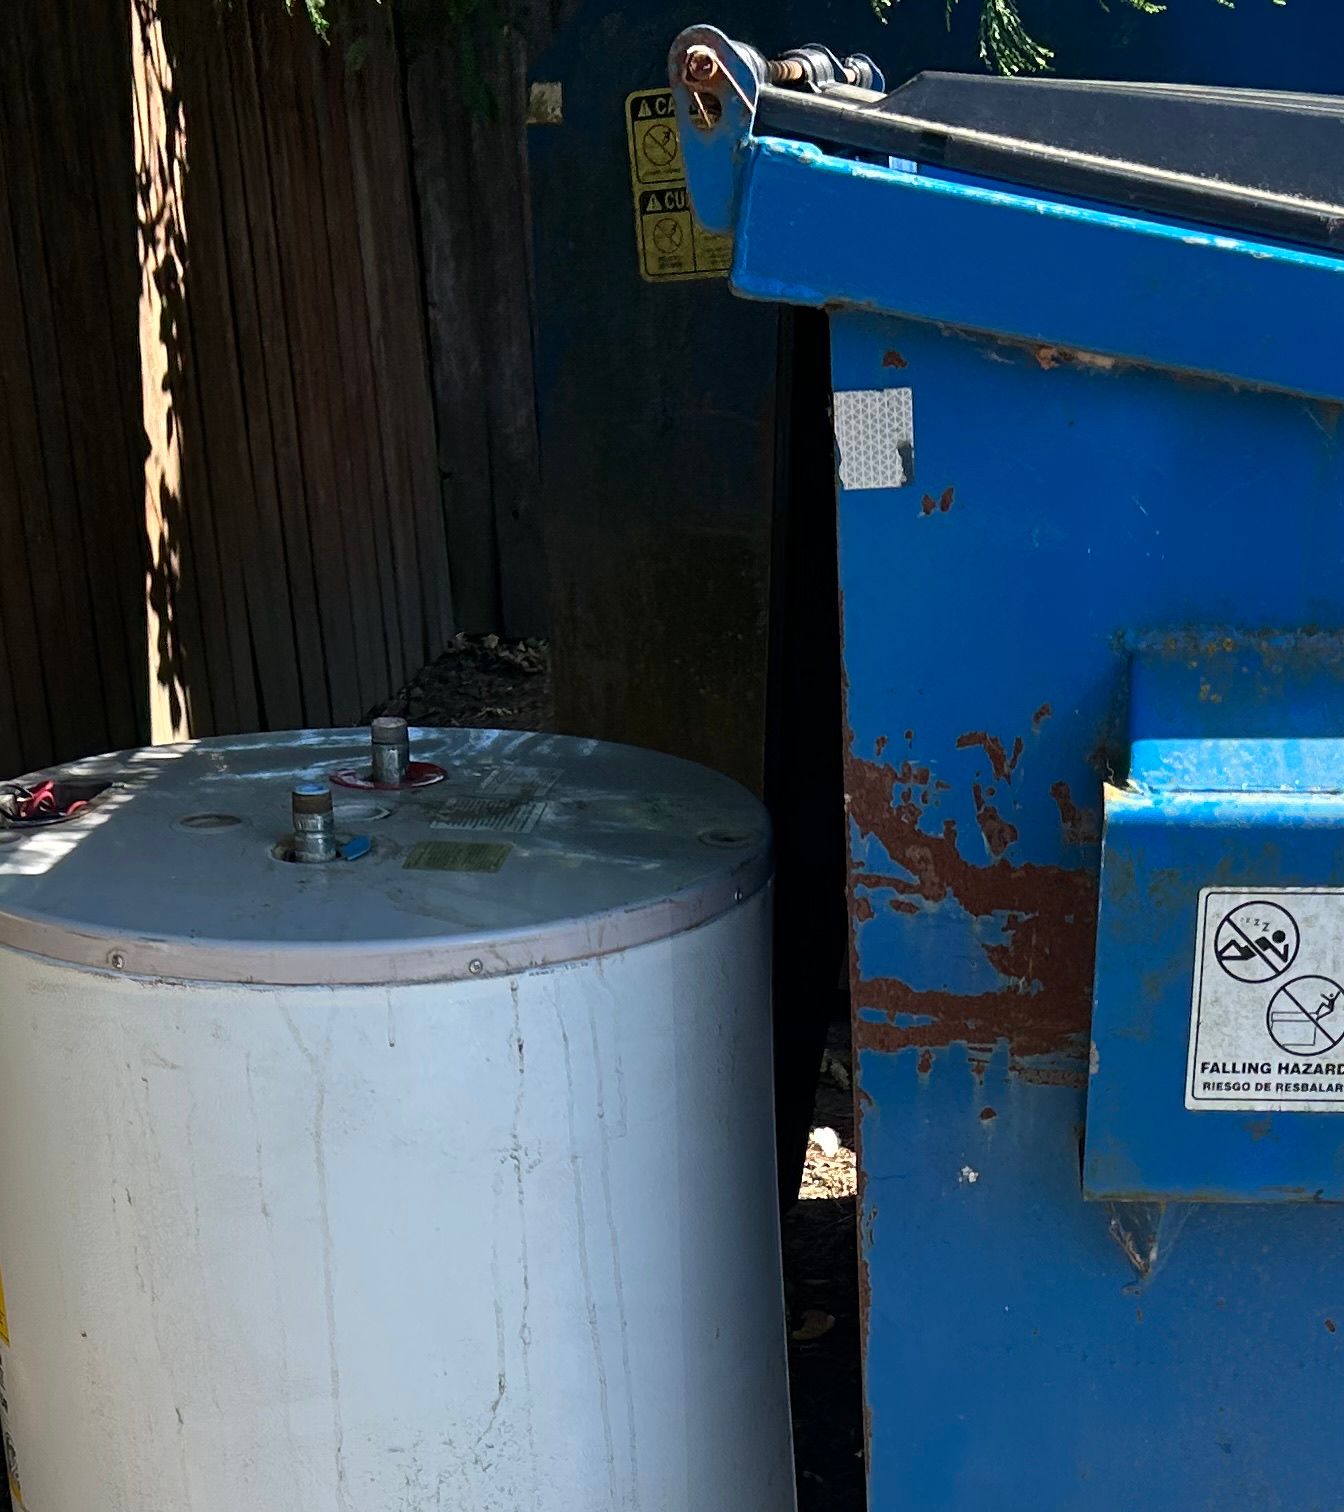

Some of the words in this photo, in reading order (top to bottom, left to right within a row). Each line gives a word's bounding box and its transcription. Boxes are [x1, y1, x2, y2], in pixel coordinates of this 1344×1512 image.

[1201, 1062, 1271, 1074] FALLING
[1203, 1082, 1250, 1091] RIESGO
[1255, 1083, 1271, 1091] DE
[1276, 1083, 1343, 1092] RESBALAR
